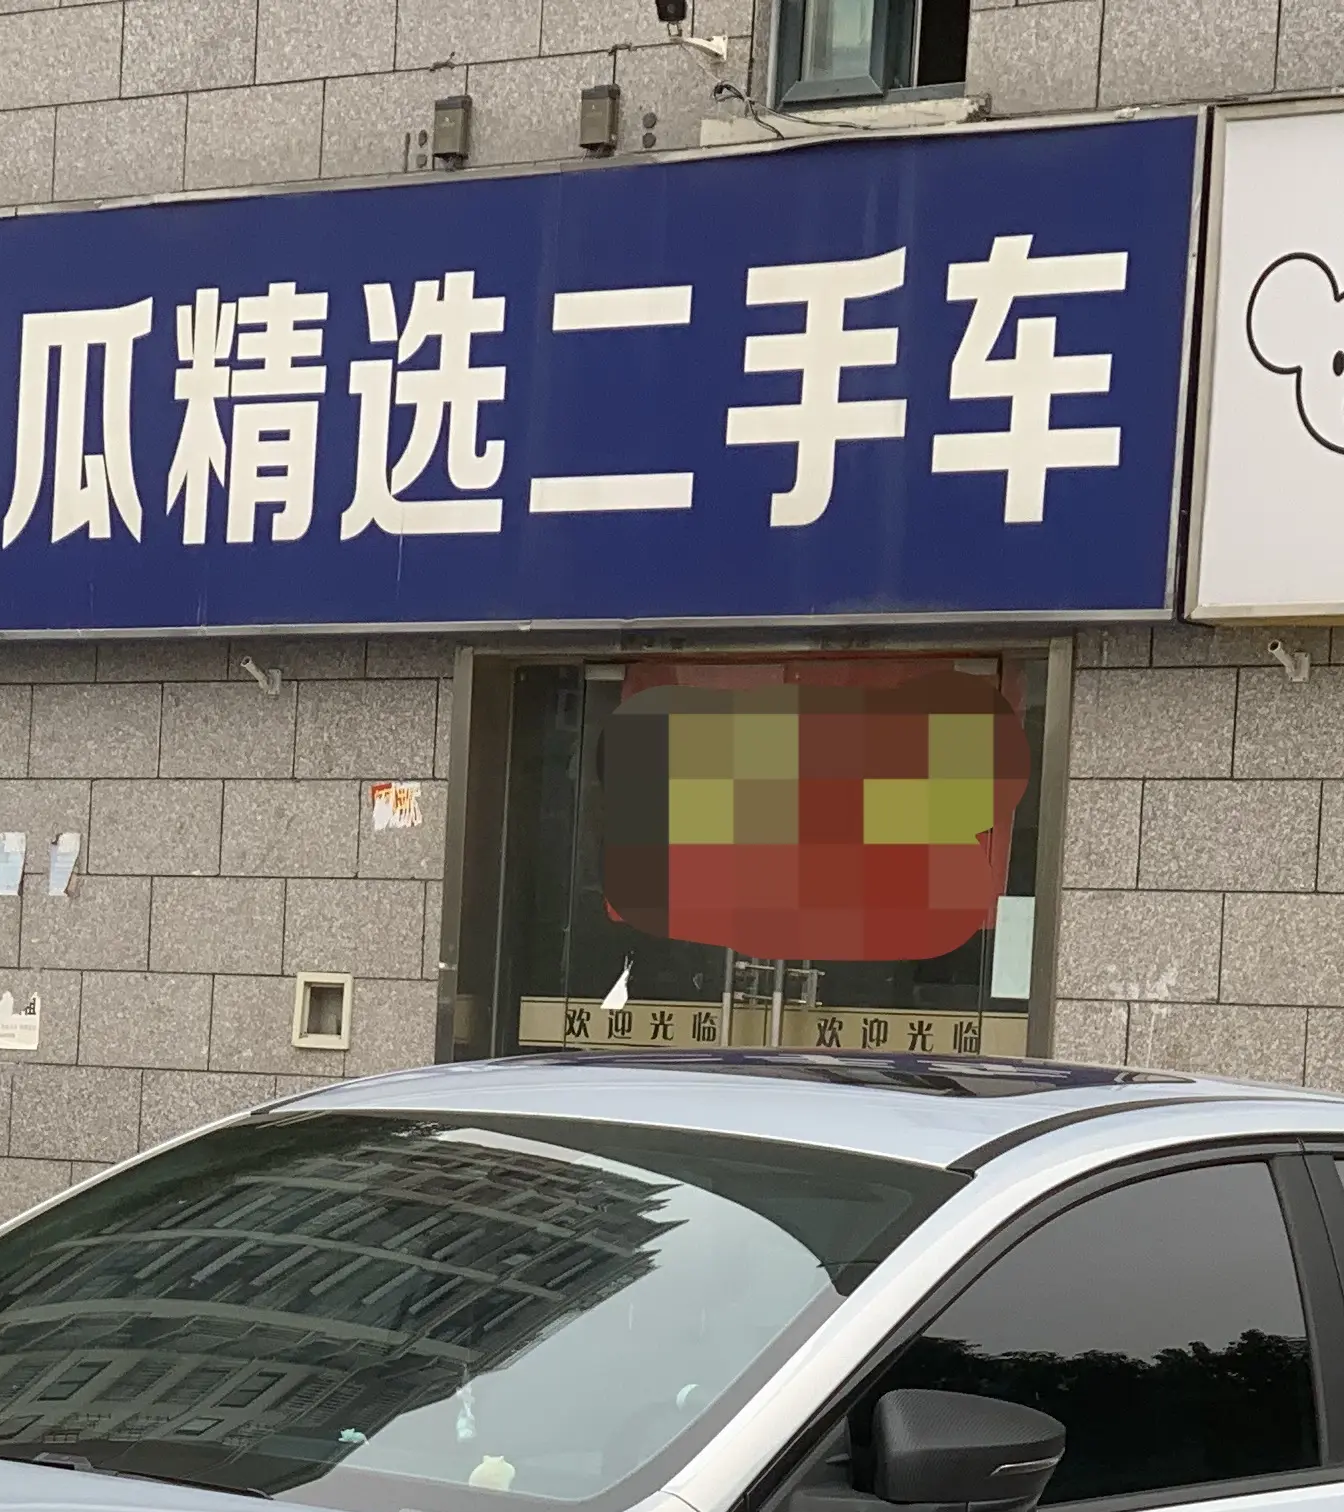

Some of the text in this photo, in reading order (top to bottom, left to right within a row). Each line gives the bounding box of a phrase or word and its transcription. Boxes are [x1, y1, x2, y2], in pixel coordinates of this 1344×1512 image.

[565, 1007, 719, 1042] 欢迎光临
[815, 1015, 980, 1054] 欢迎光临
